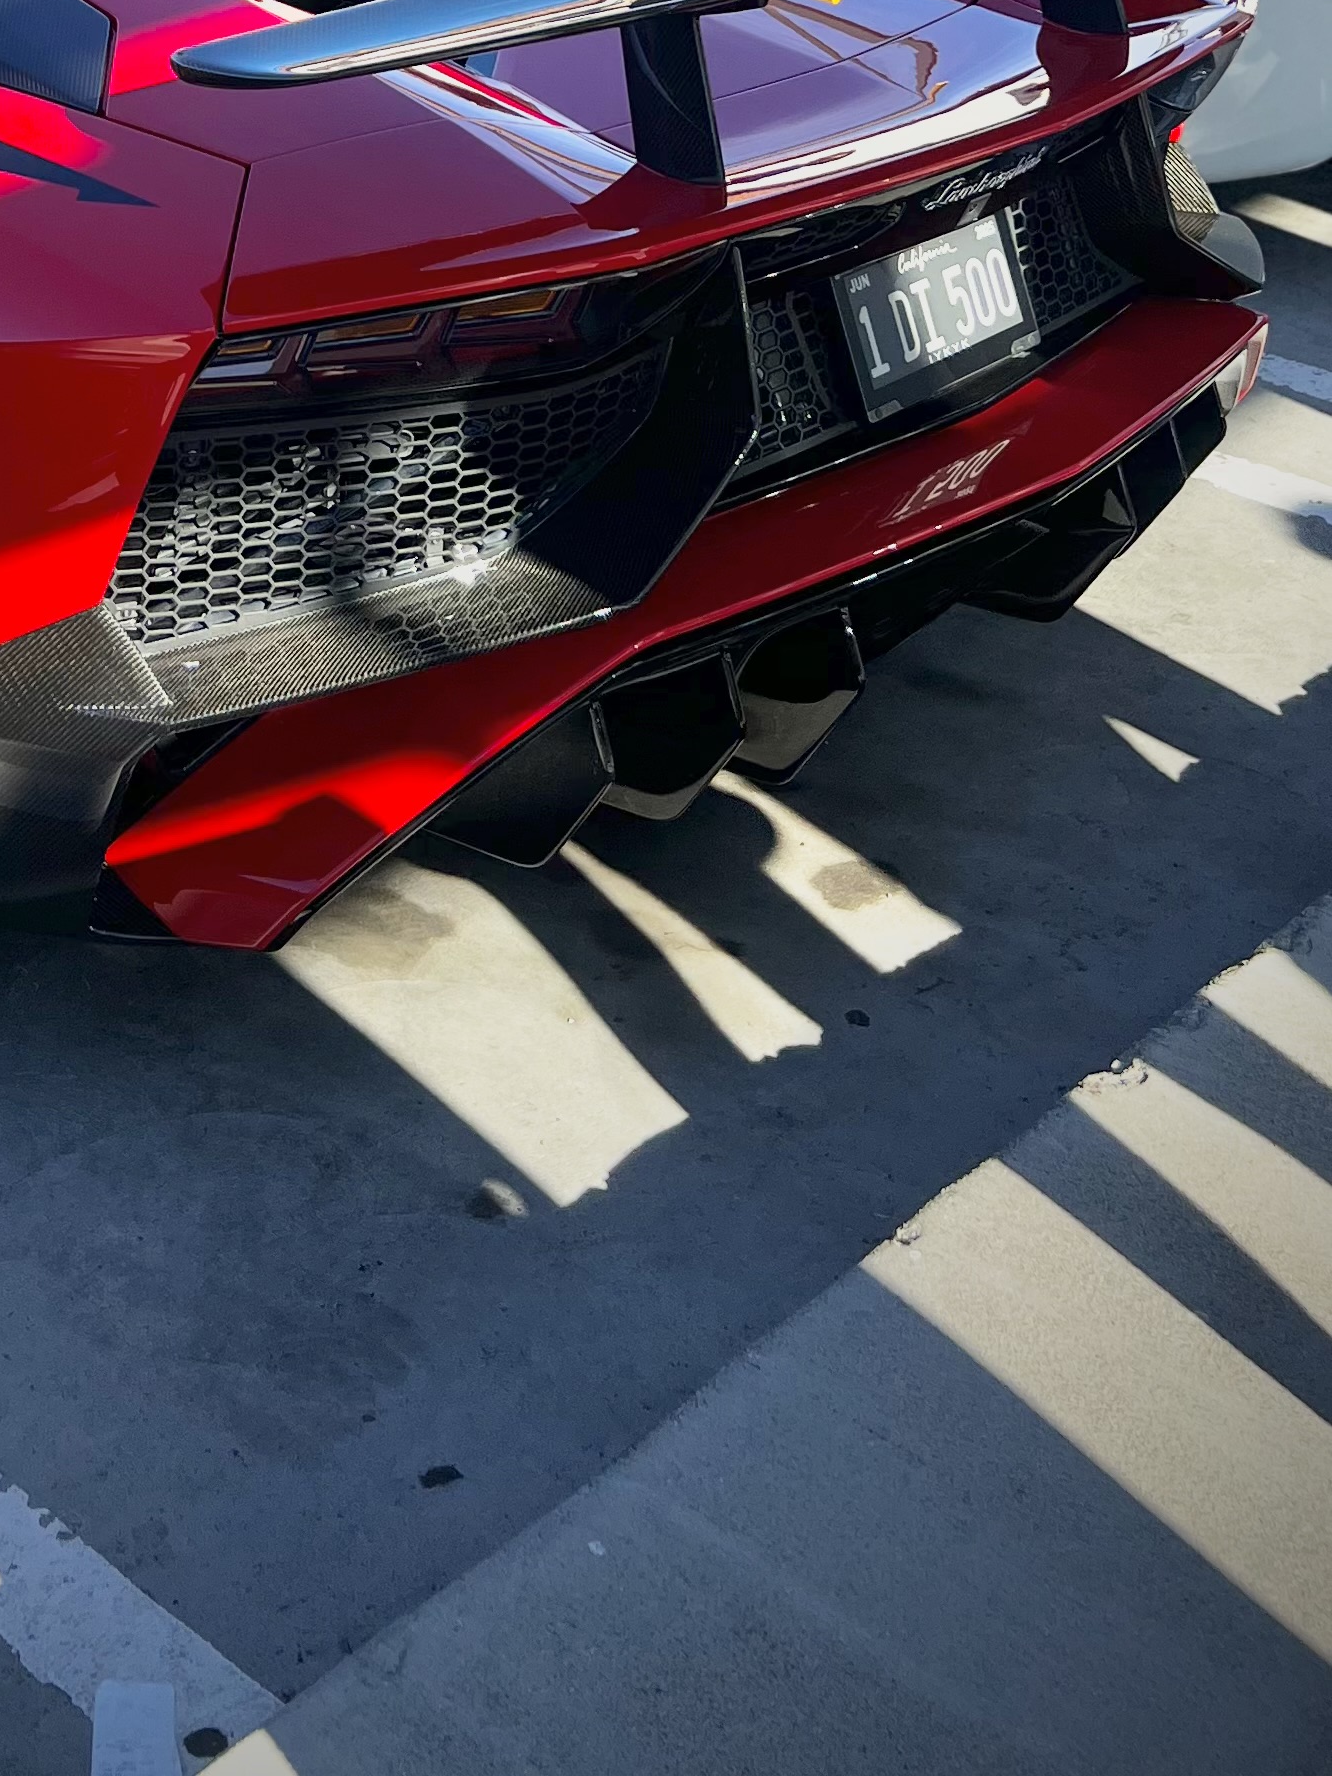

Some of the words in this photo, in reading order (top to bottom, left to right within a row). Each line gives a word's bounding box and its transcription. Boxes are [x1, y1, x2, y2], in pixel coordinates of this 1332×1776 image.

[897, 240, 958, 274] California
[850, 274, 871, 294] JUN
[859, 306, 890, 378] 1
[942, 248, 1017, 337] 500
